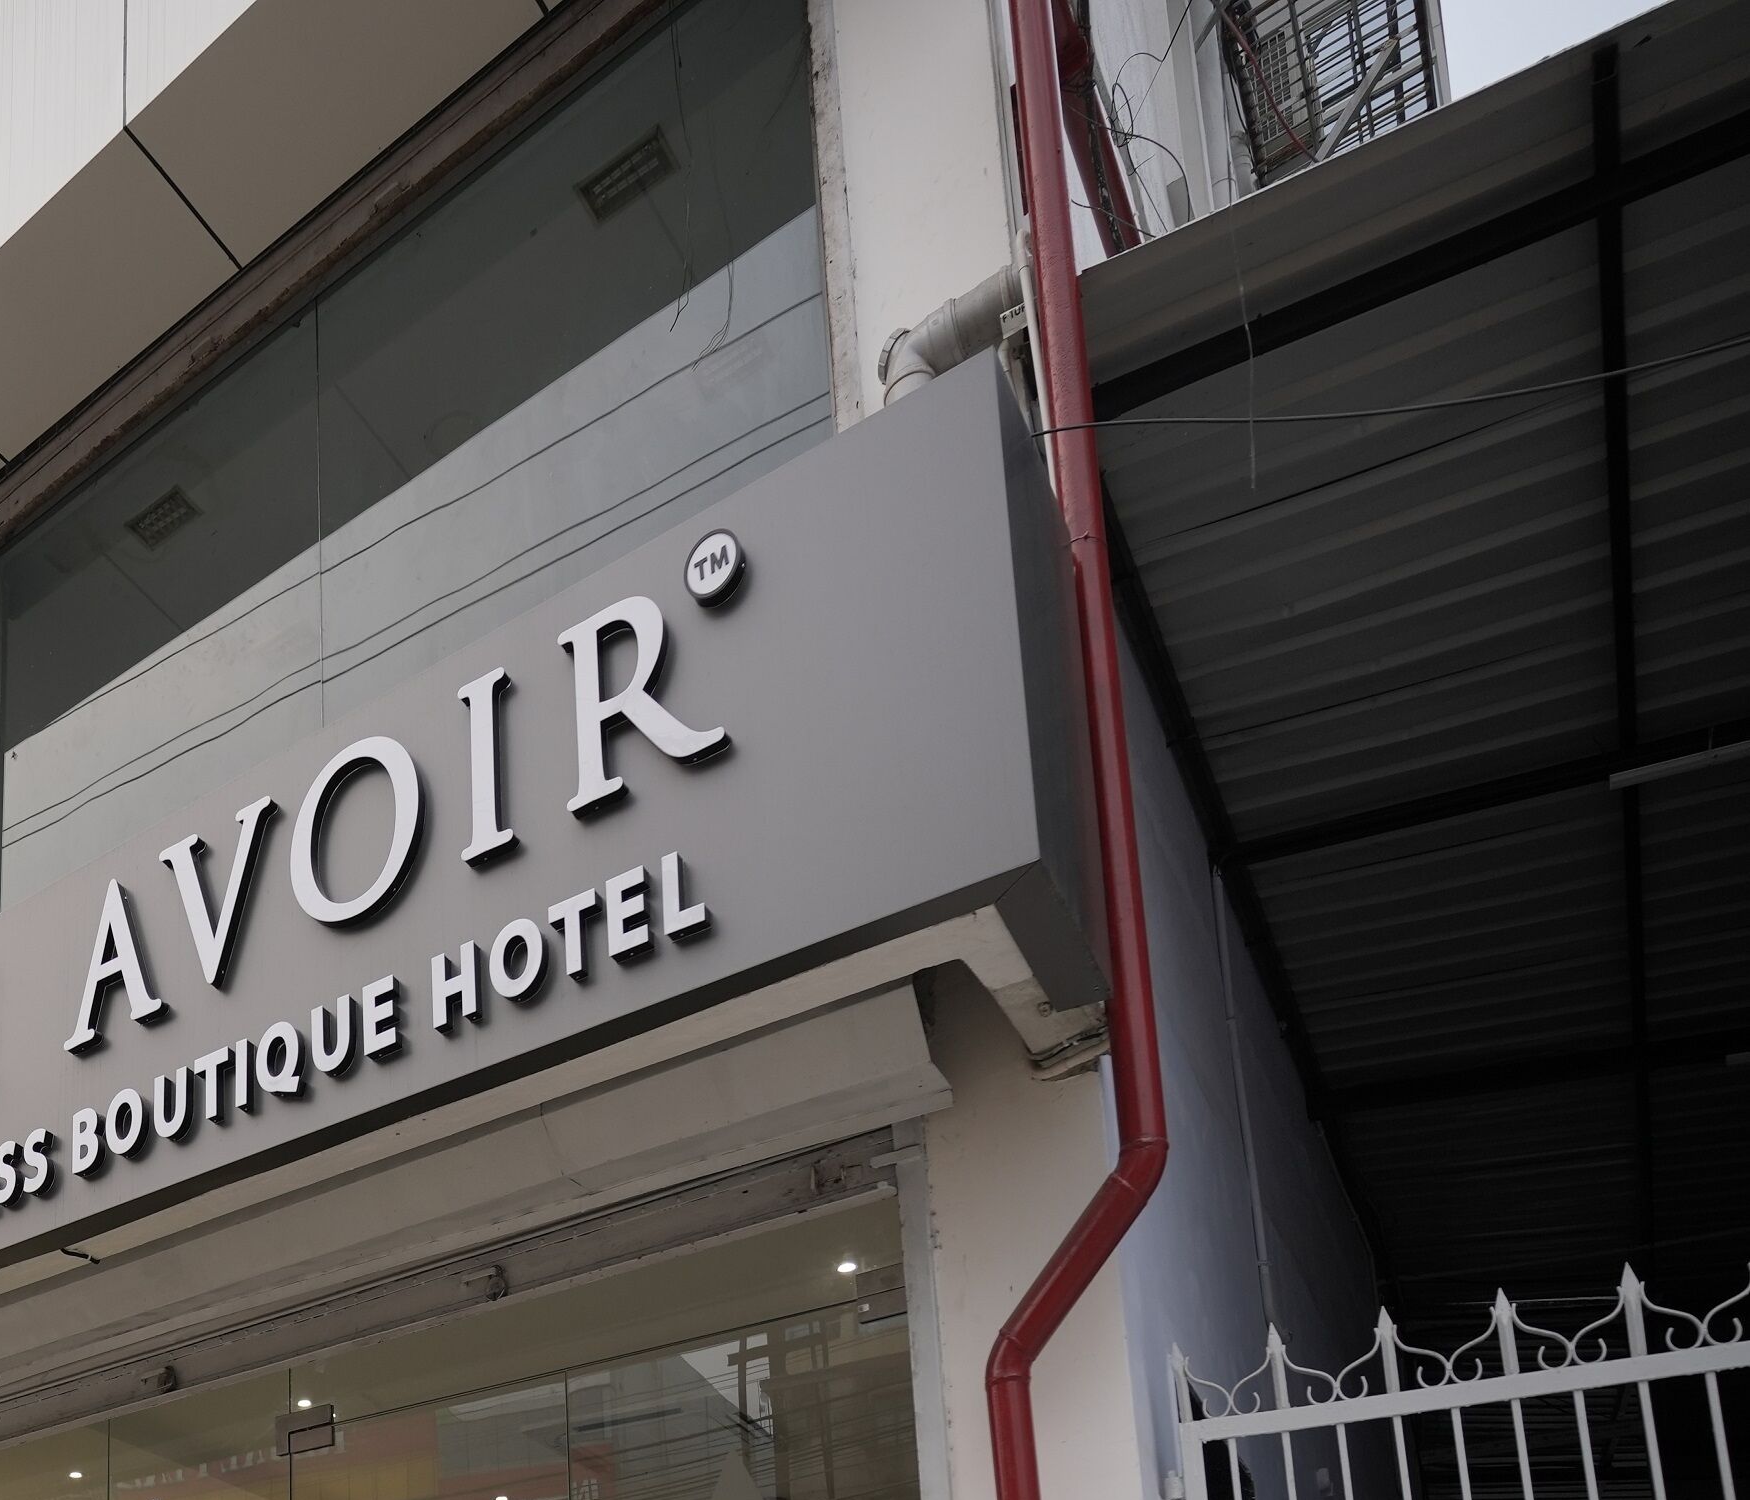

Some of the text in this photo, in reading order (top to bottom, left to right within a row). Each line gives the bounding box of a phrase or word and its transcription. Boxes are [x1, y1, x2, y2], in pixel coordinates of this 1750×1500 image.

[694, 544, 729, 581] TM
[64, 596, 730, 1055] AVOIR
[72, 975, 401, 1177] BOUTIQUE
[431, 851, 708, 1033] HOTEL
